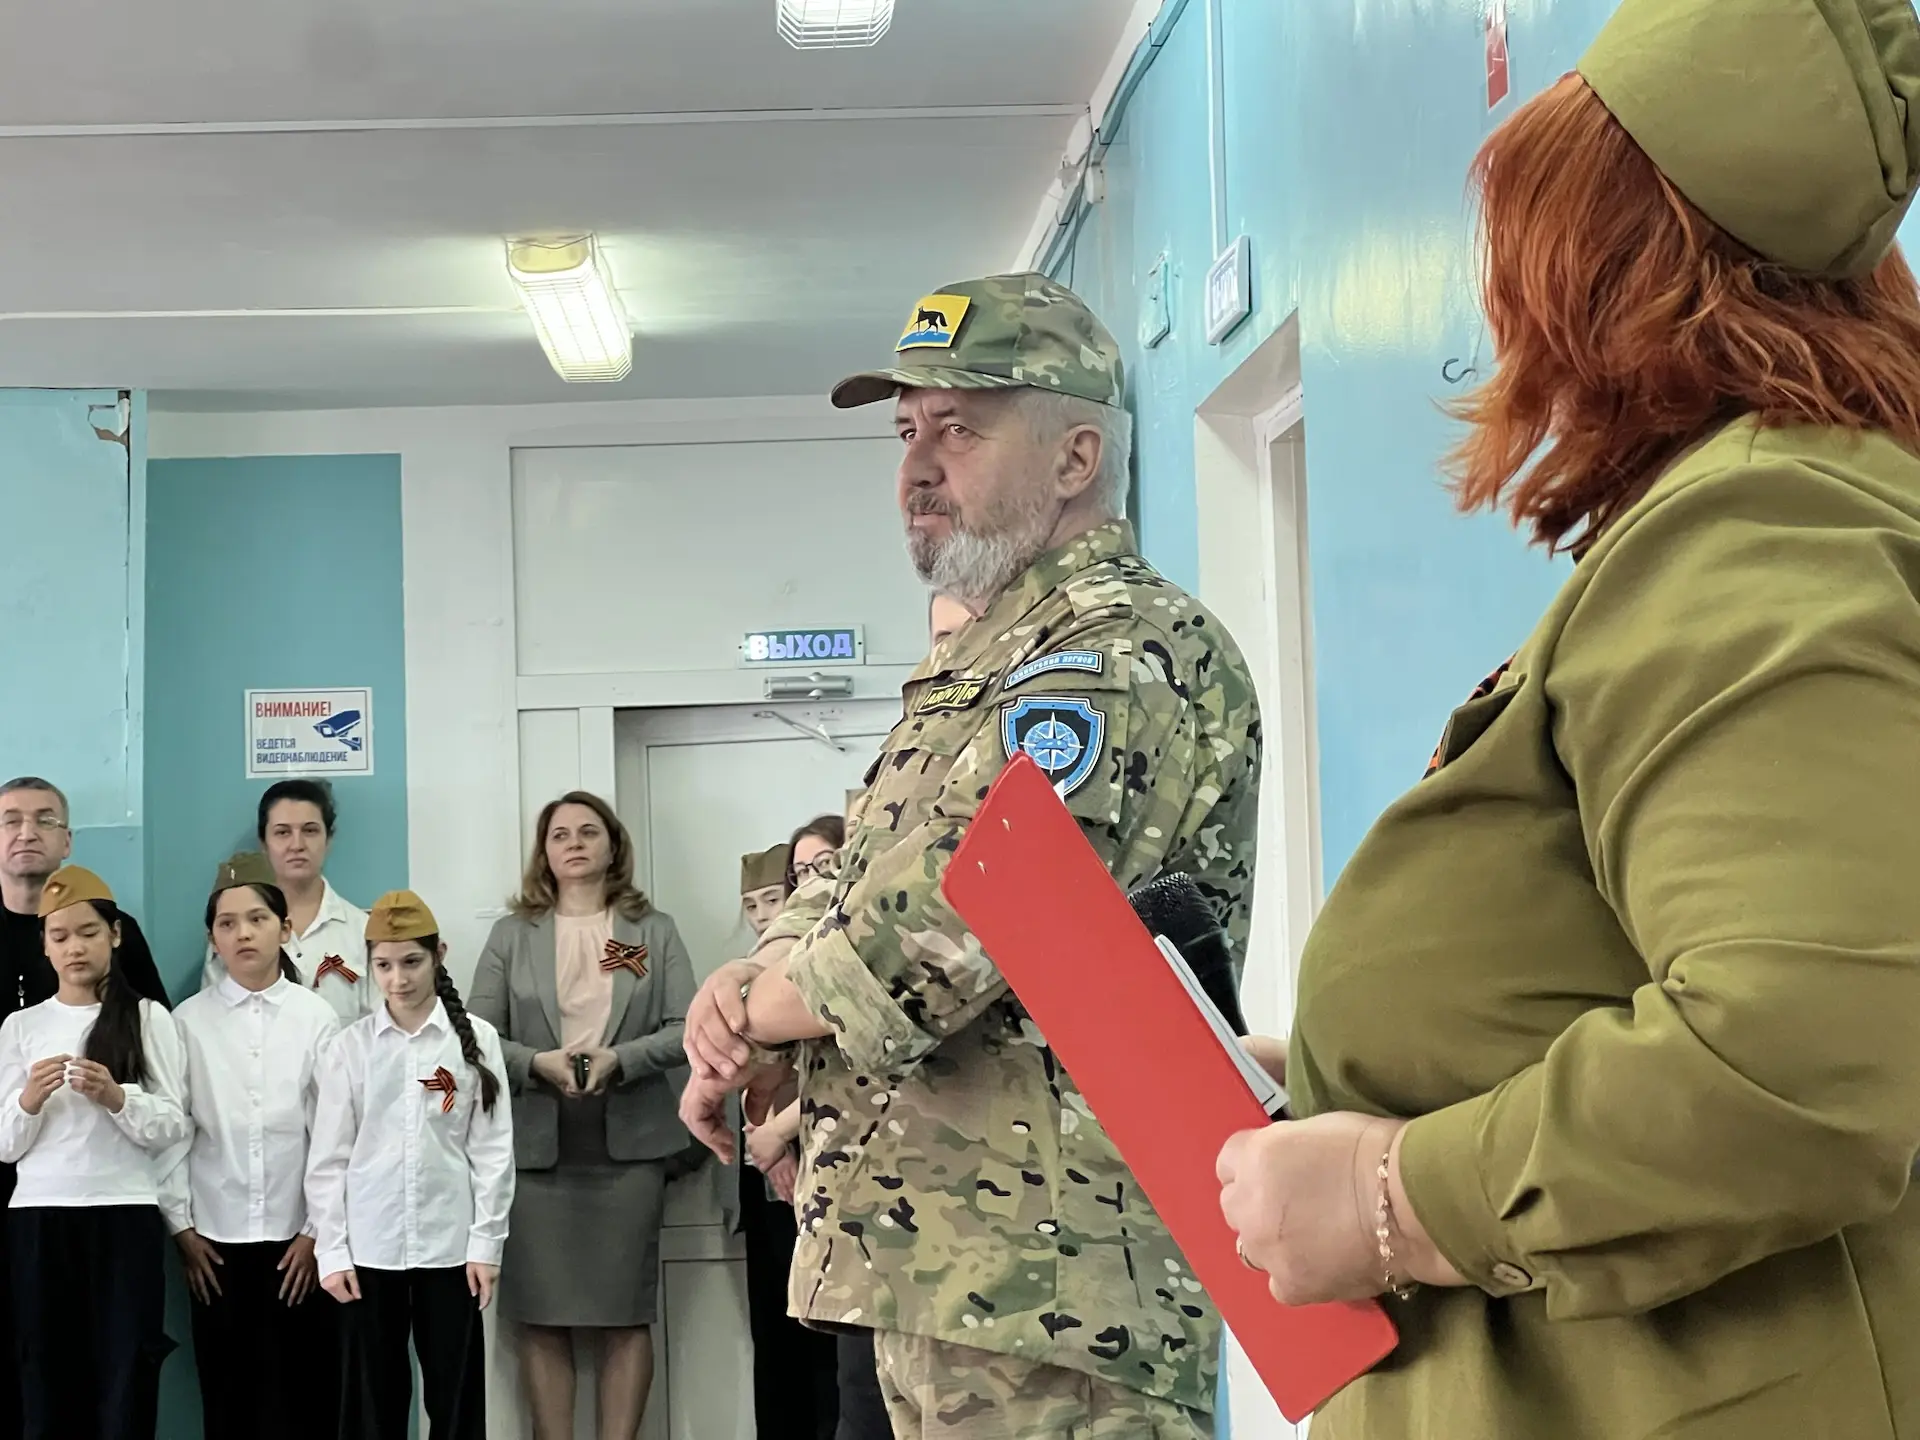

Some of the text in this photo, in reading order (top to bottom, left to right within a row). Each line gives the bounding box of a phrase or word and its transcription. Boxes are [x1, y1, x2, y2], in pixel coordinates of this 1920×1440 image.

[749, 633, 853, 660] ВЫХОД
[256, 702, 331, 717] ВНИМАНИЕ!
[256, 738, 296, 750] ВЕДЕТСЯ
[256, 751, 348, 763] ВИДЕОНАБЛЮДЕНИЕ
